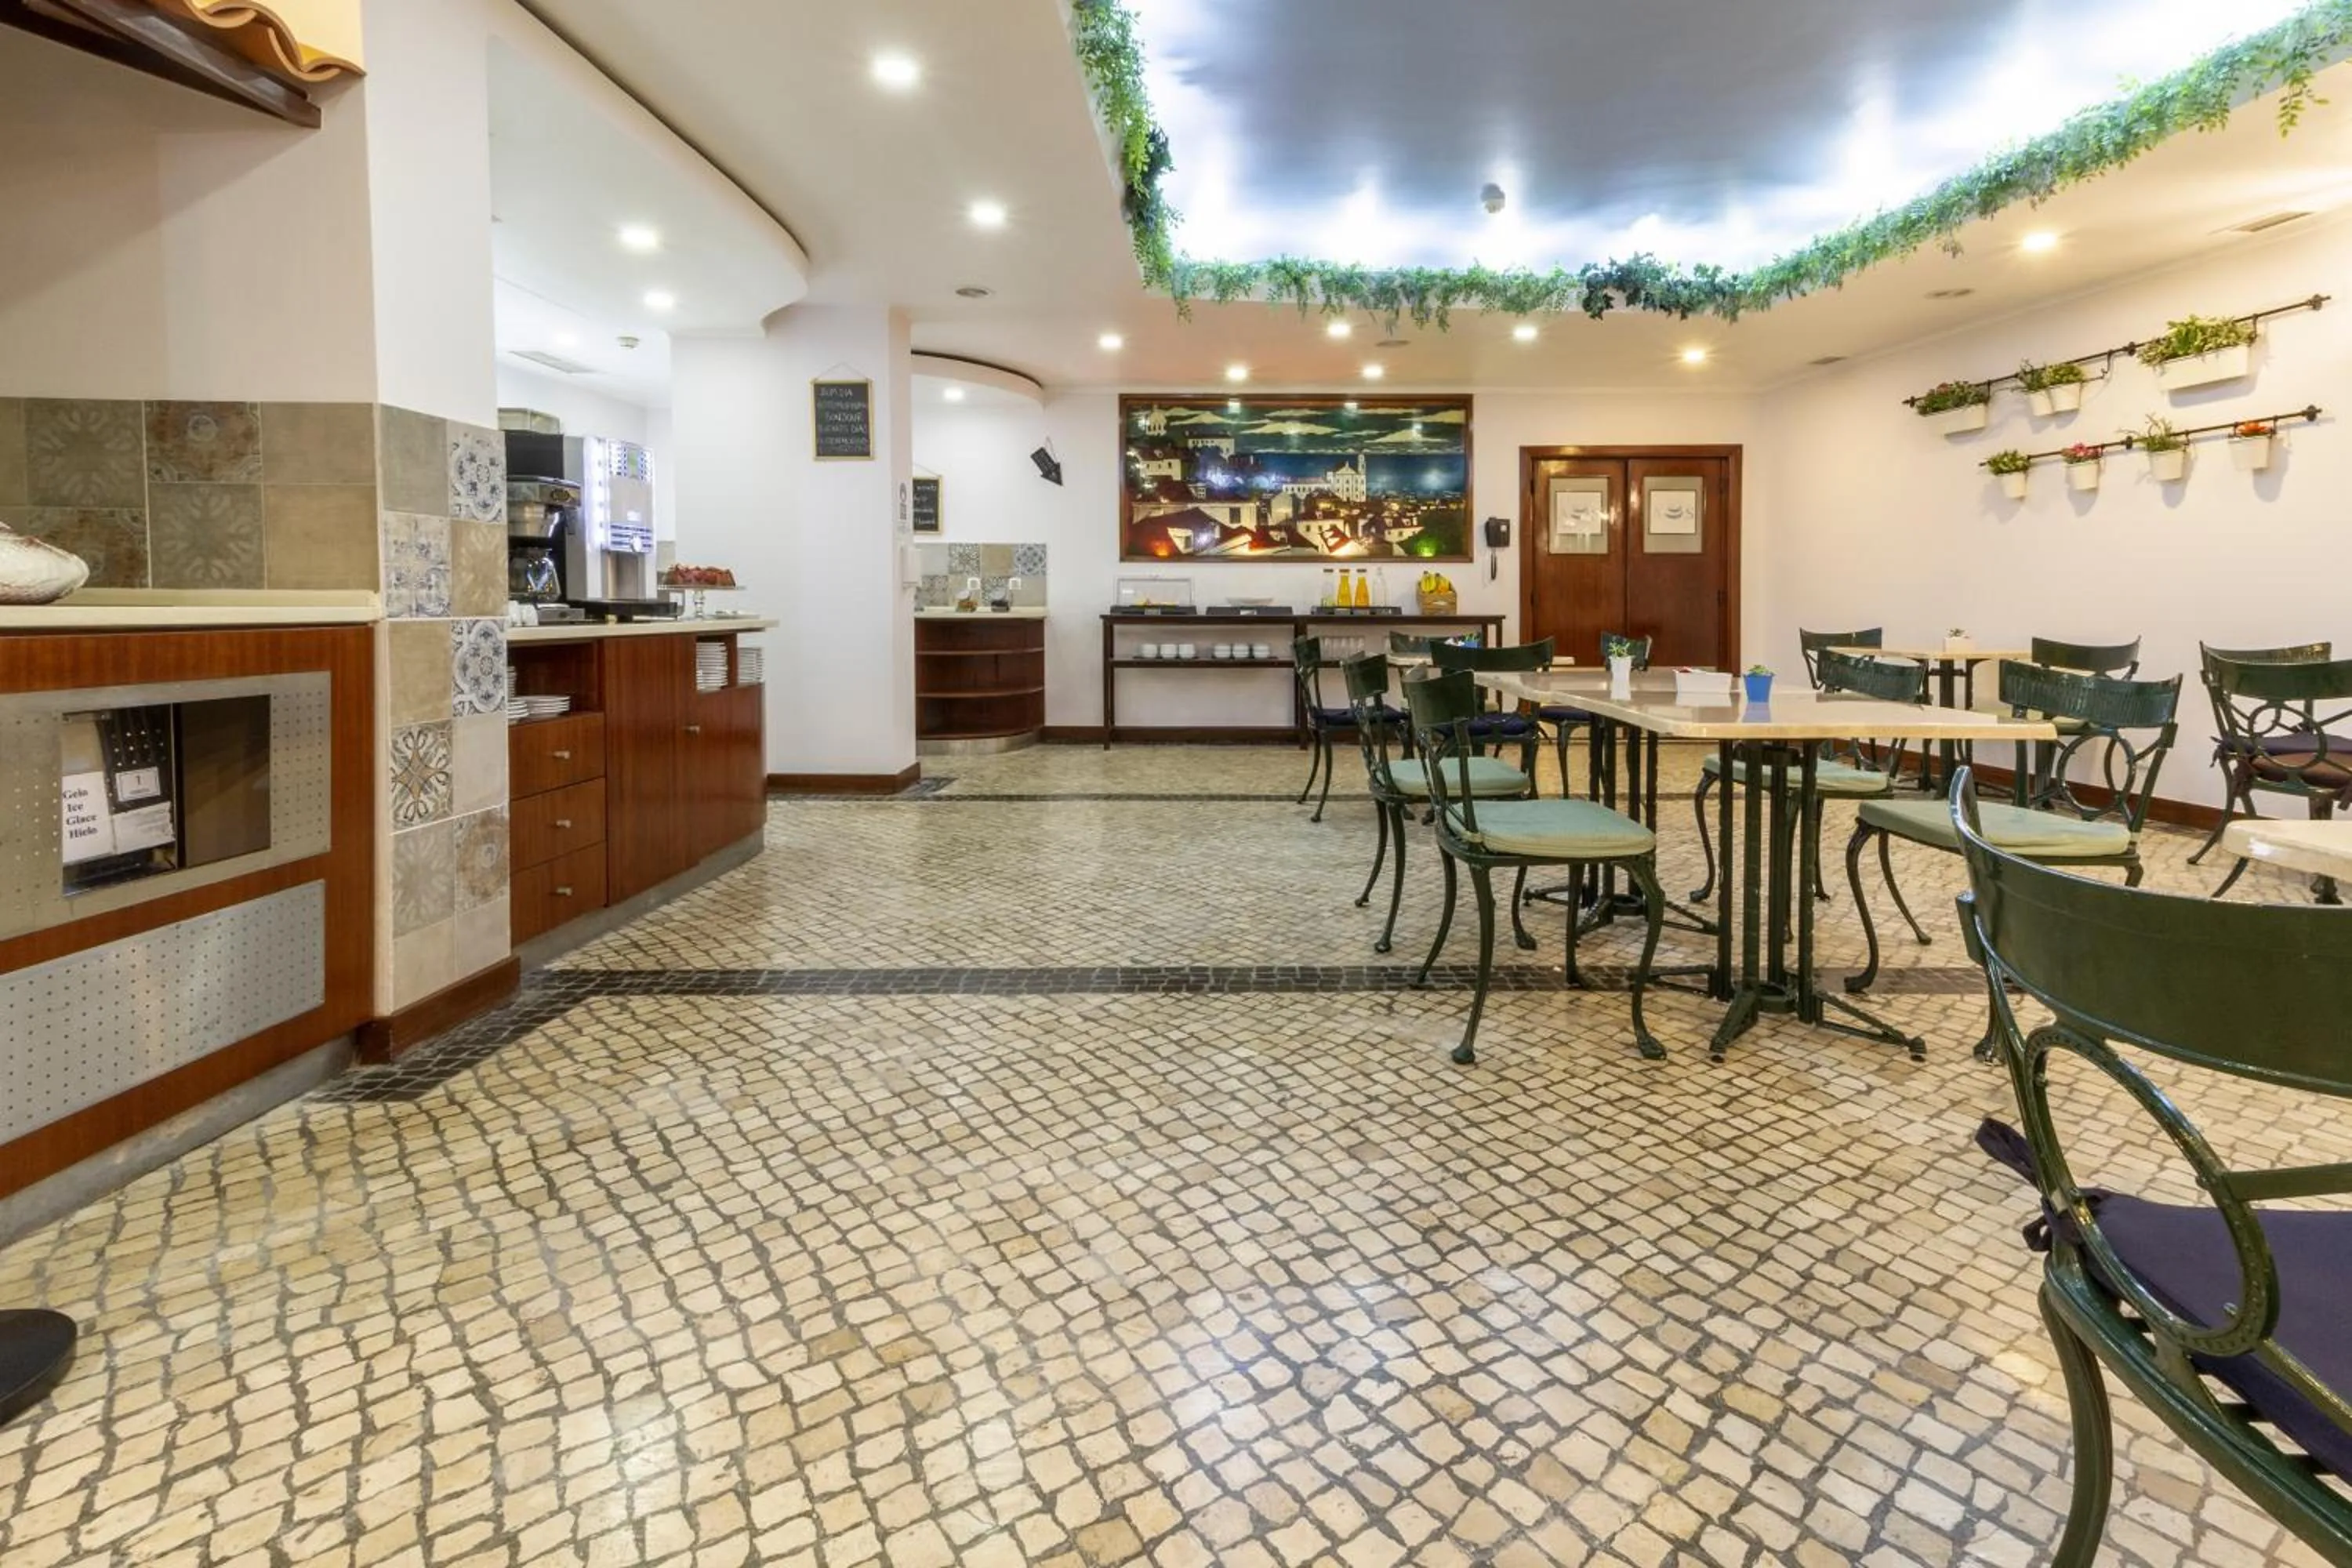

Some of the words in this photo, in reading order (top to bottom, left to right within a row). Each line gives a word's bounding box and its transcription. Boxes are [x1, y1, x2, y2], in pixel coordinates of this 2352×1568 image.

[62, 788, 89, 799] Gelo
[67, 804, 83, 813] Ice
[66, 815, 97, 826] Glace
[69, 826, 98, 839] Hielo
